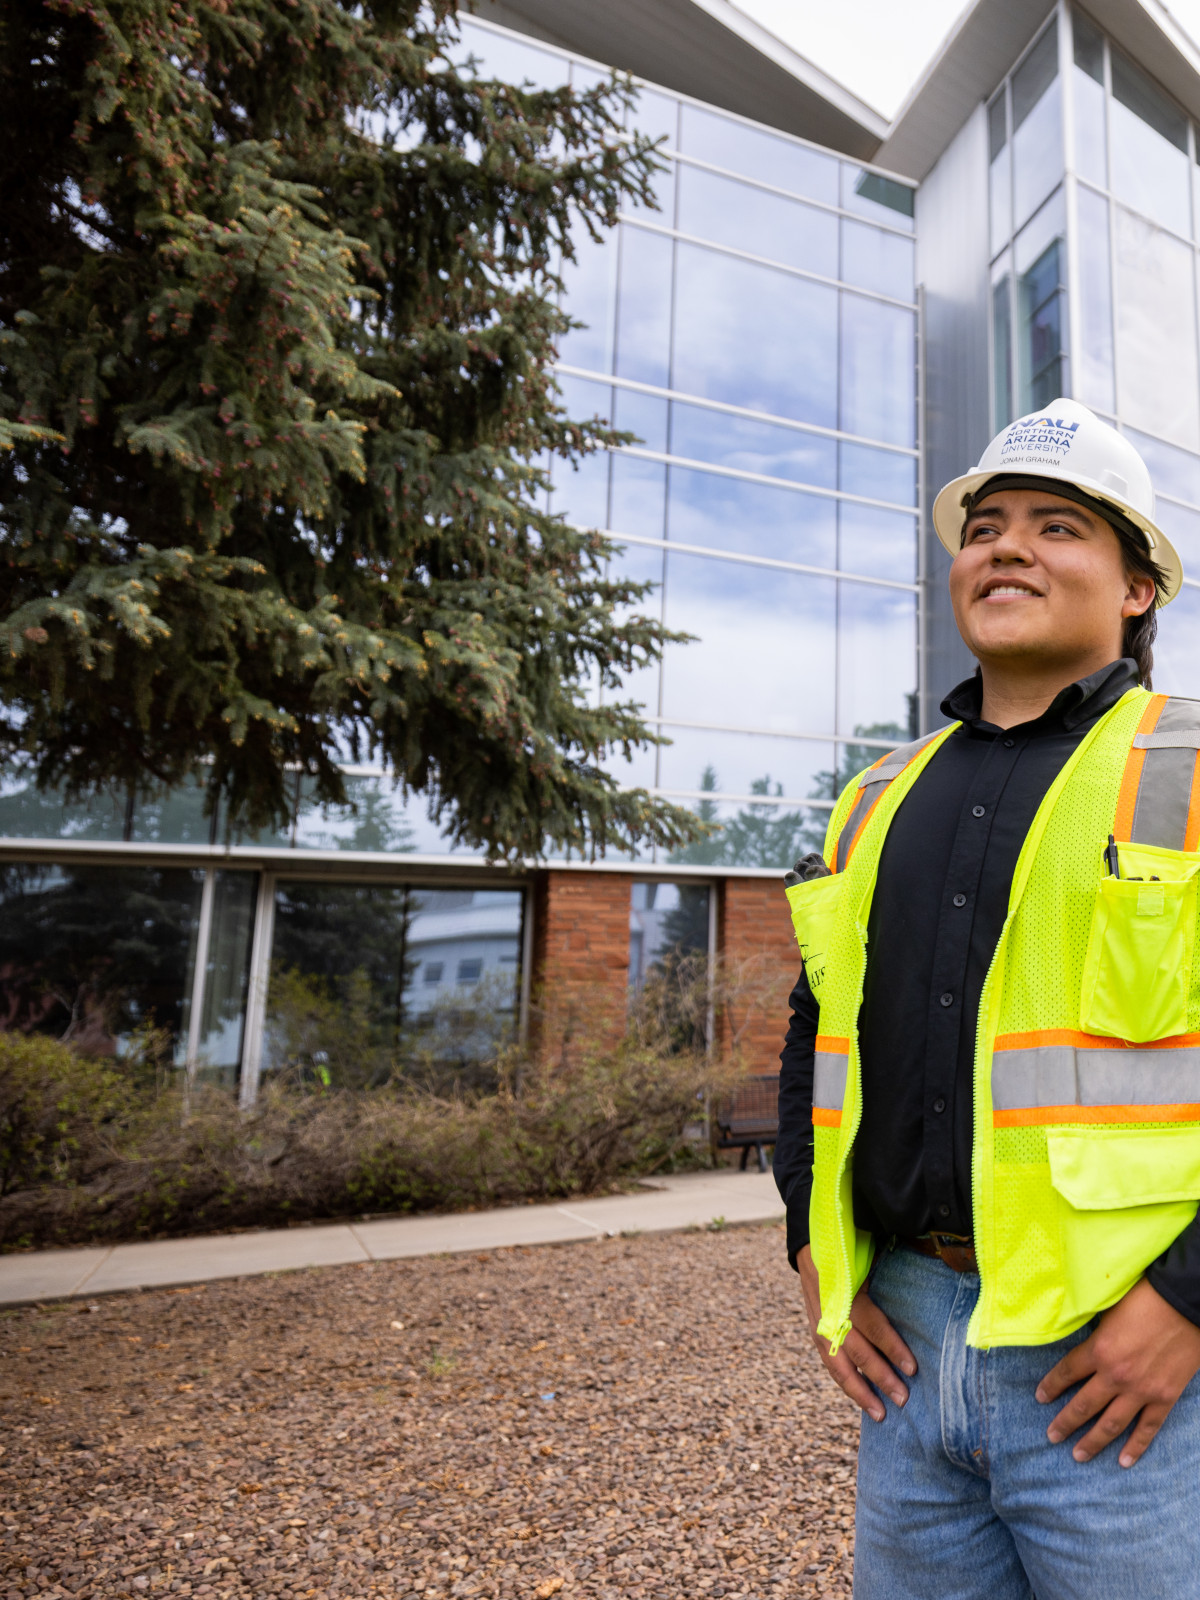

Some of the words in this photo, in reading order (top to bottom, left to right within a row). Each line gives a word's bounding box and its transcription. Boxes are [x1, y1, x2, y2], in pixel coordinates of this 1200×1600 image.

[1011, 417, 1080, 432] NAU
[1007, 428, 1074, 439] NORTHERN
[1003, 435, 1070, 448] ARIZONA
[1001, 444, 1070, 456] UNIVERSITY
[1000, 456, 1024, 465] JONAH
[1025, 456, 1060, 466] GRAHAM
